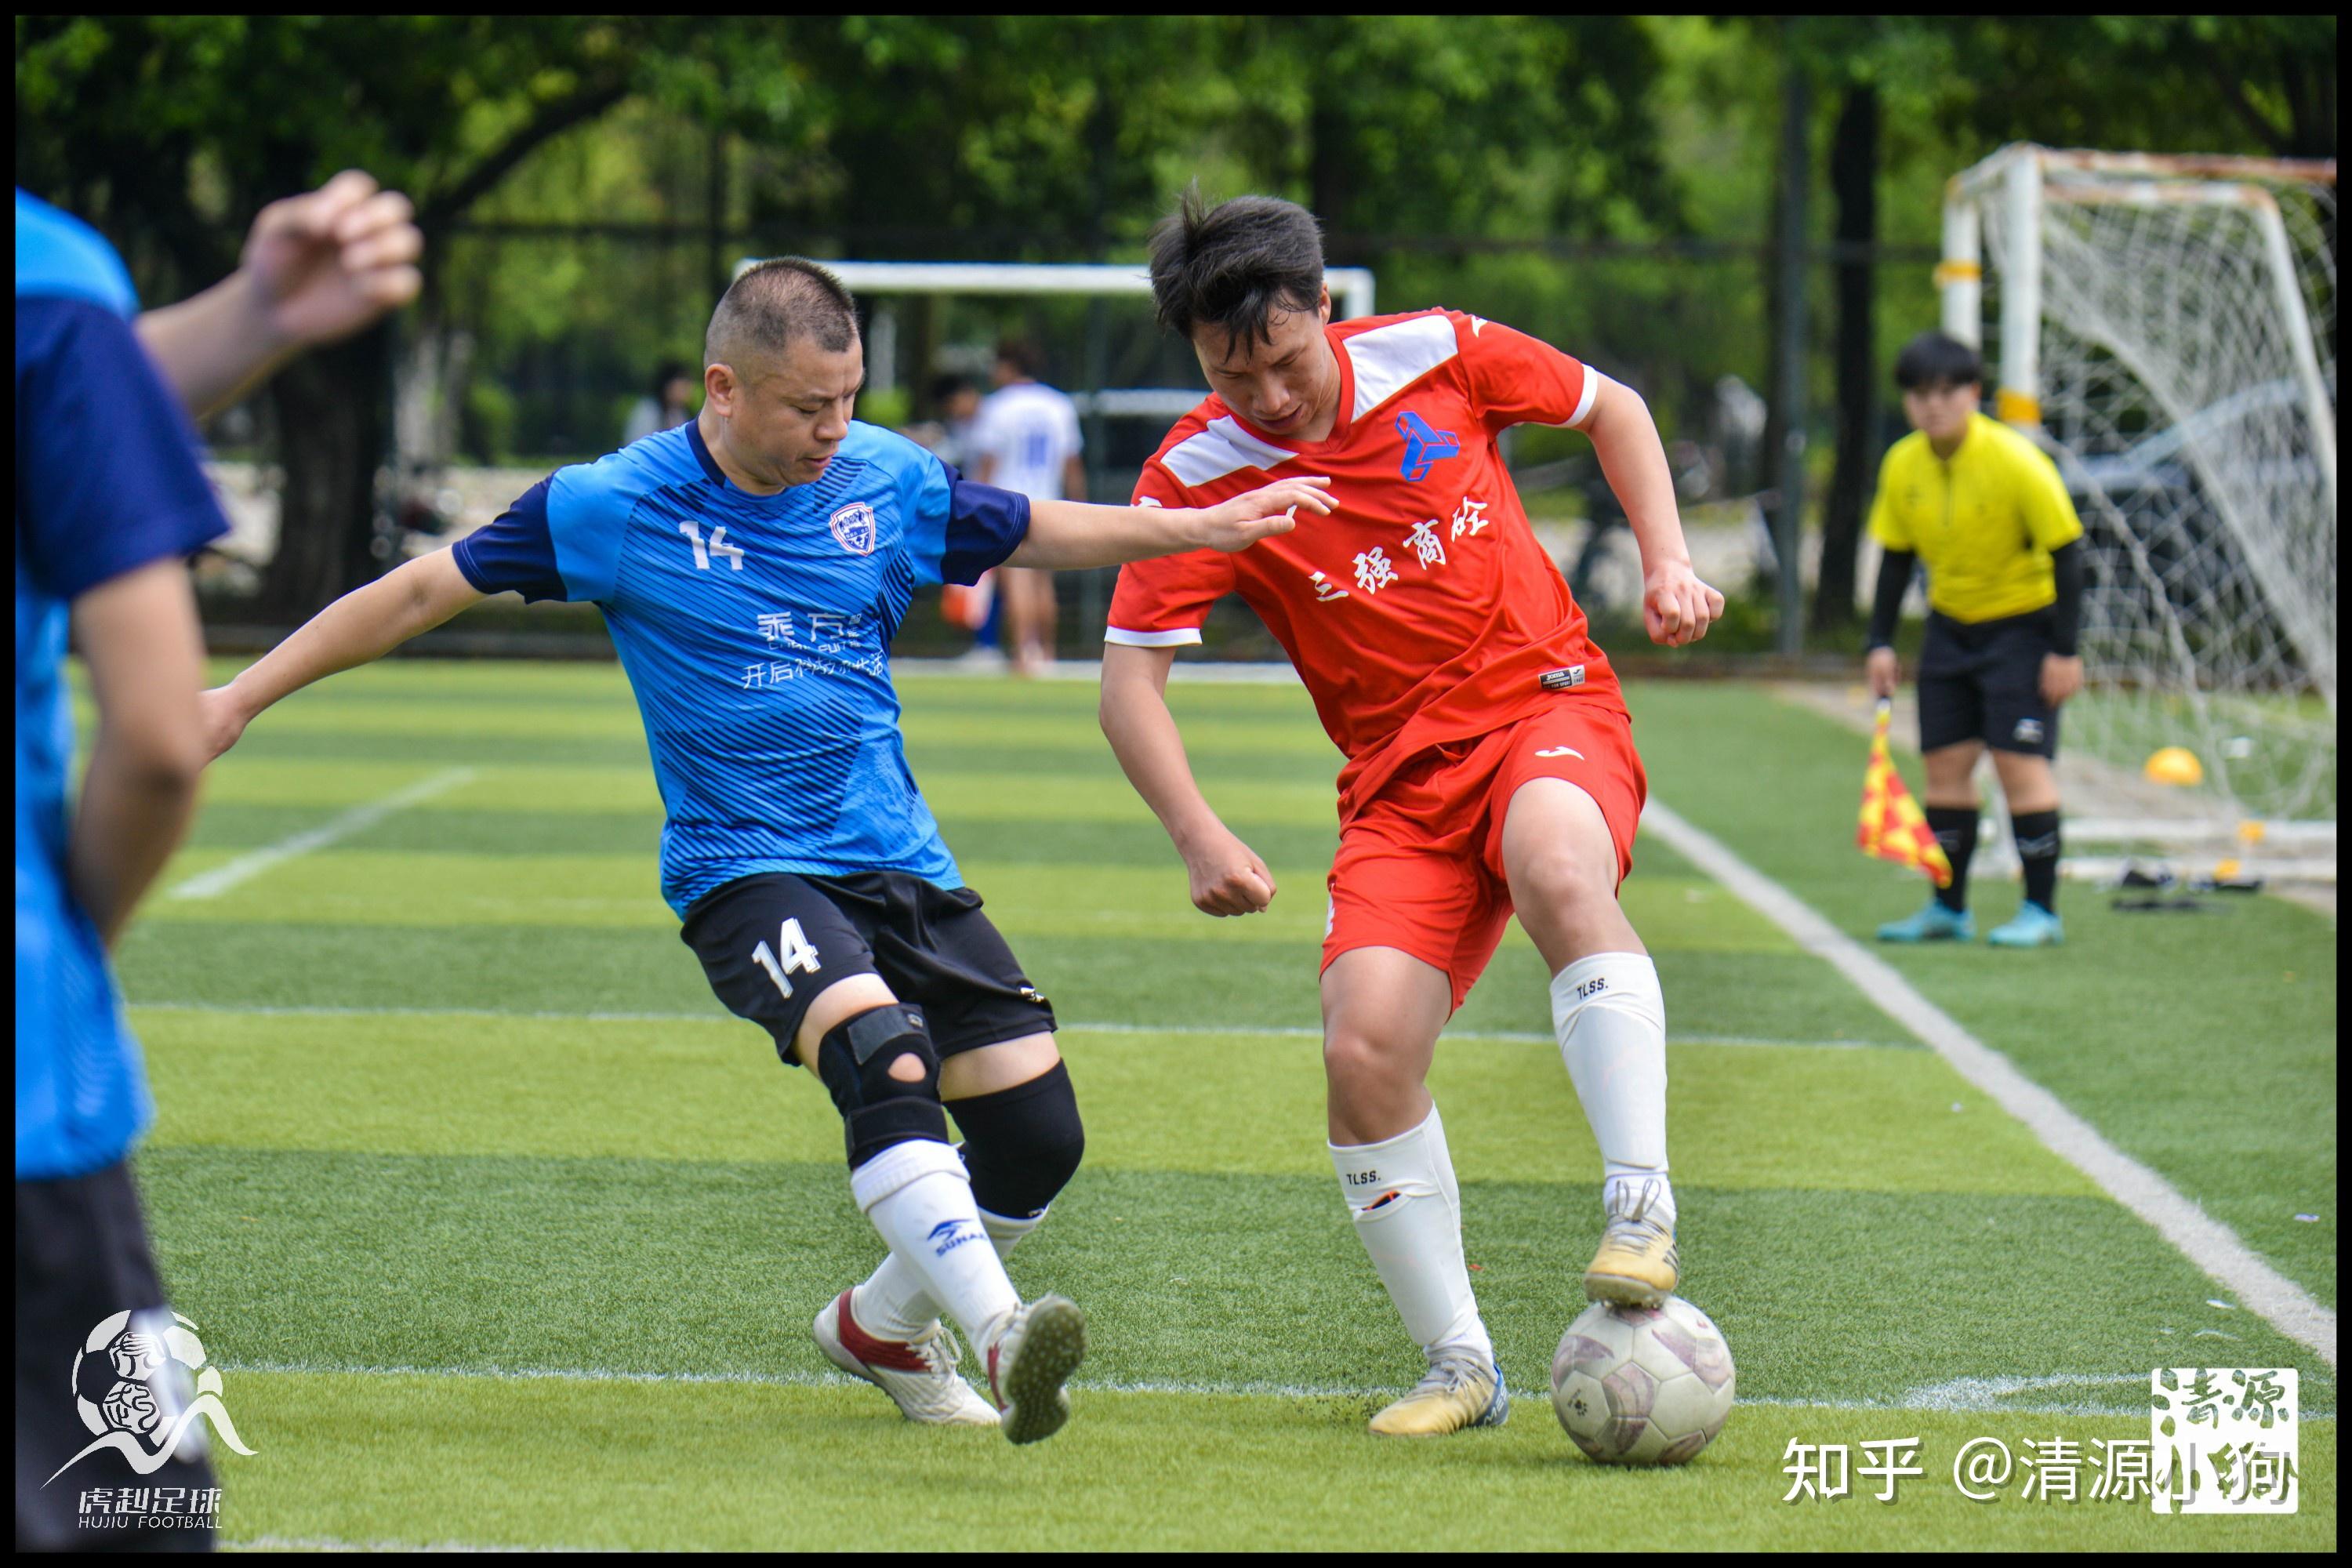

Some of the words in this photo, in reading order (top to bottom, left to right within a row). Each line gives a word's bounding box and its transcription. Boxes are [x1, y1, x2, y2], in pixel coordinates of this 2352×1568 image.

[679, 520, 744, 570] 14
[751, 916, 821, 1000] 14
[1577, 977, 1609, 1000] TLSS.
[1346, 1170, 1381, 1185] TLSS.
